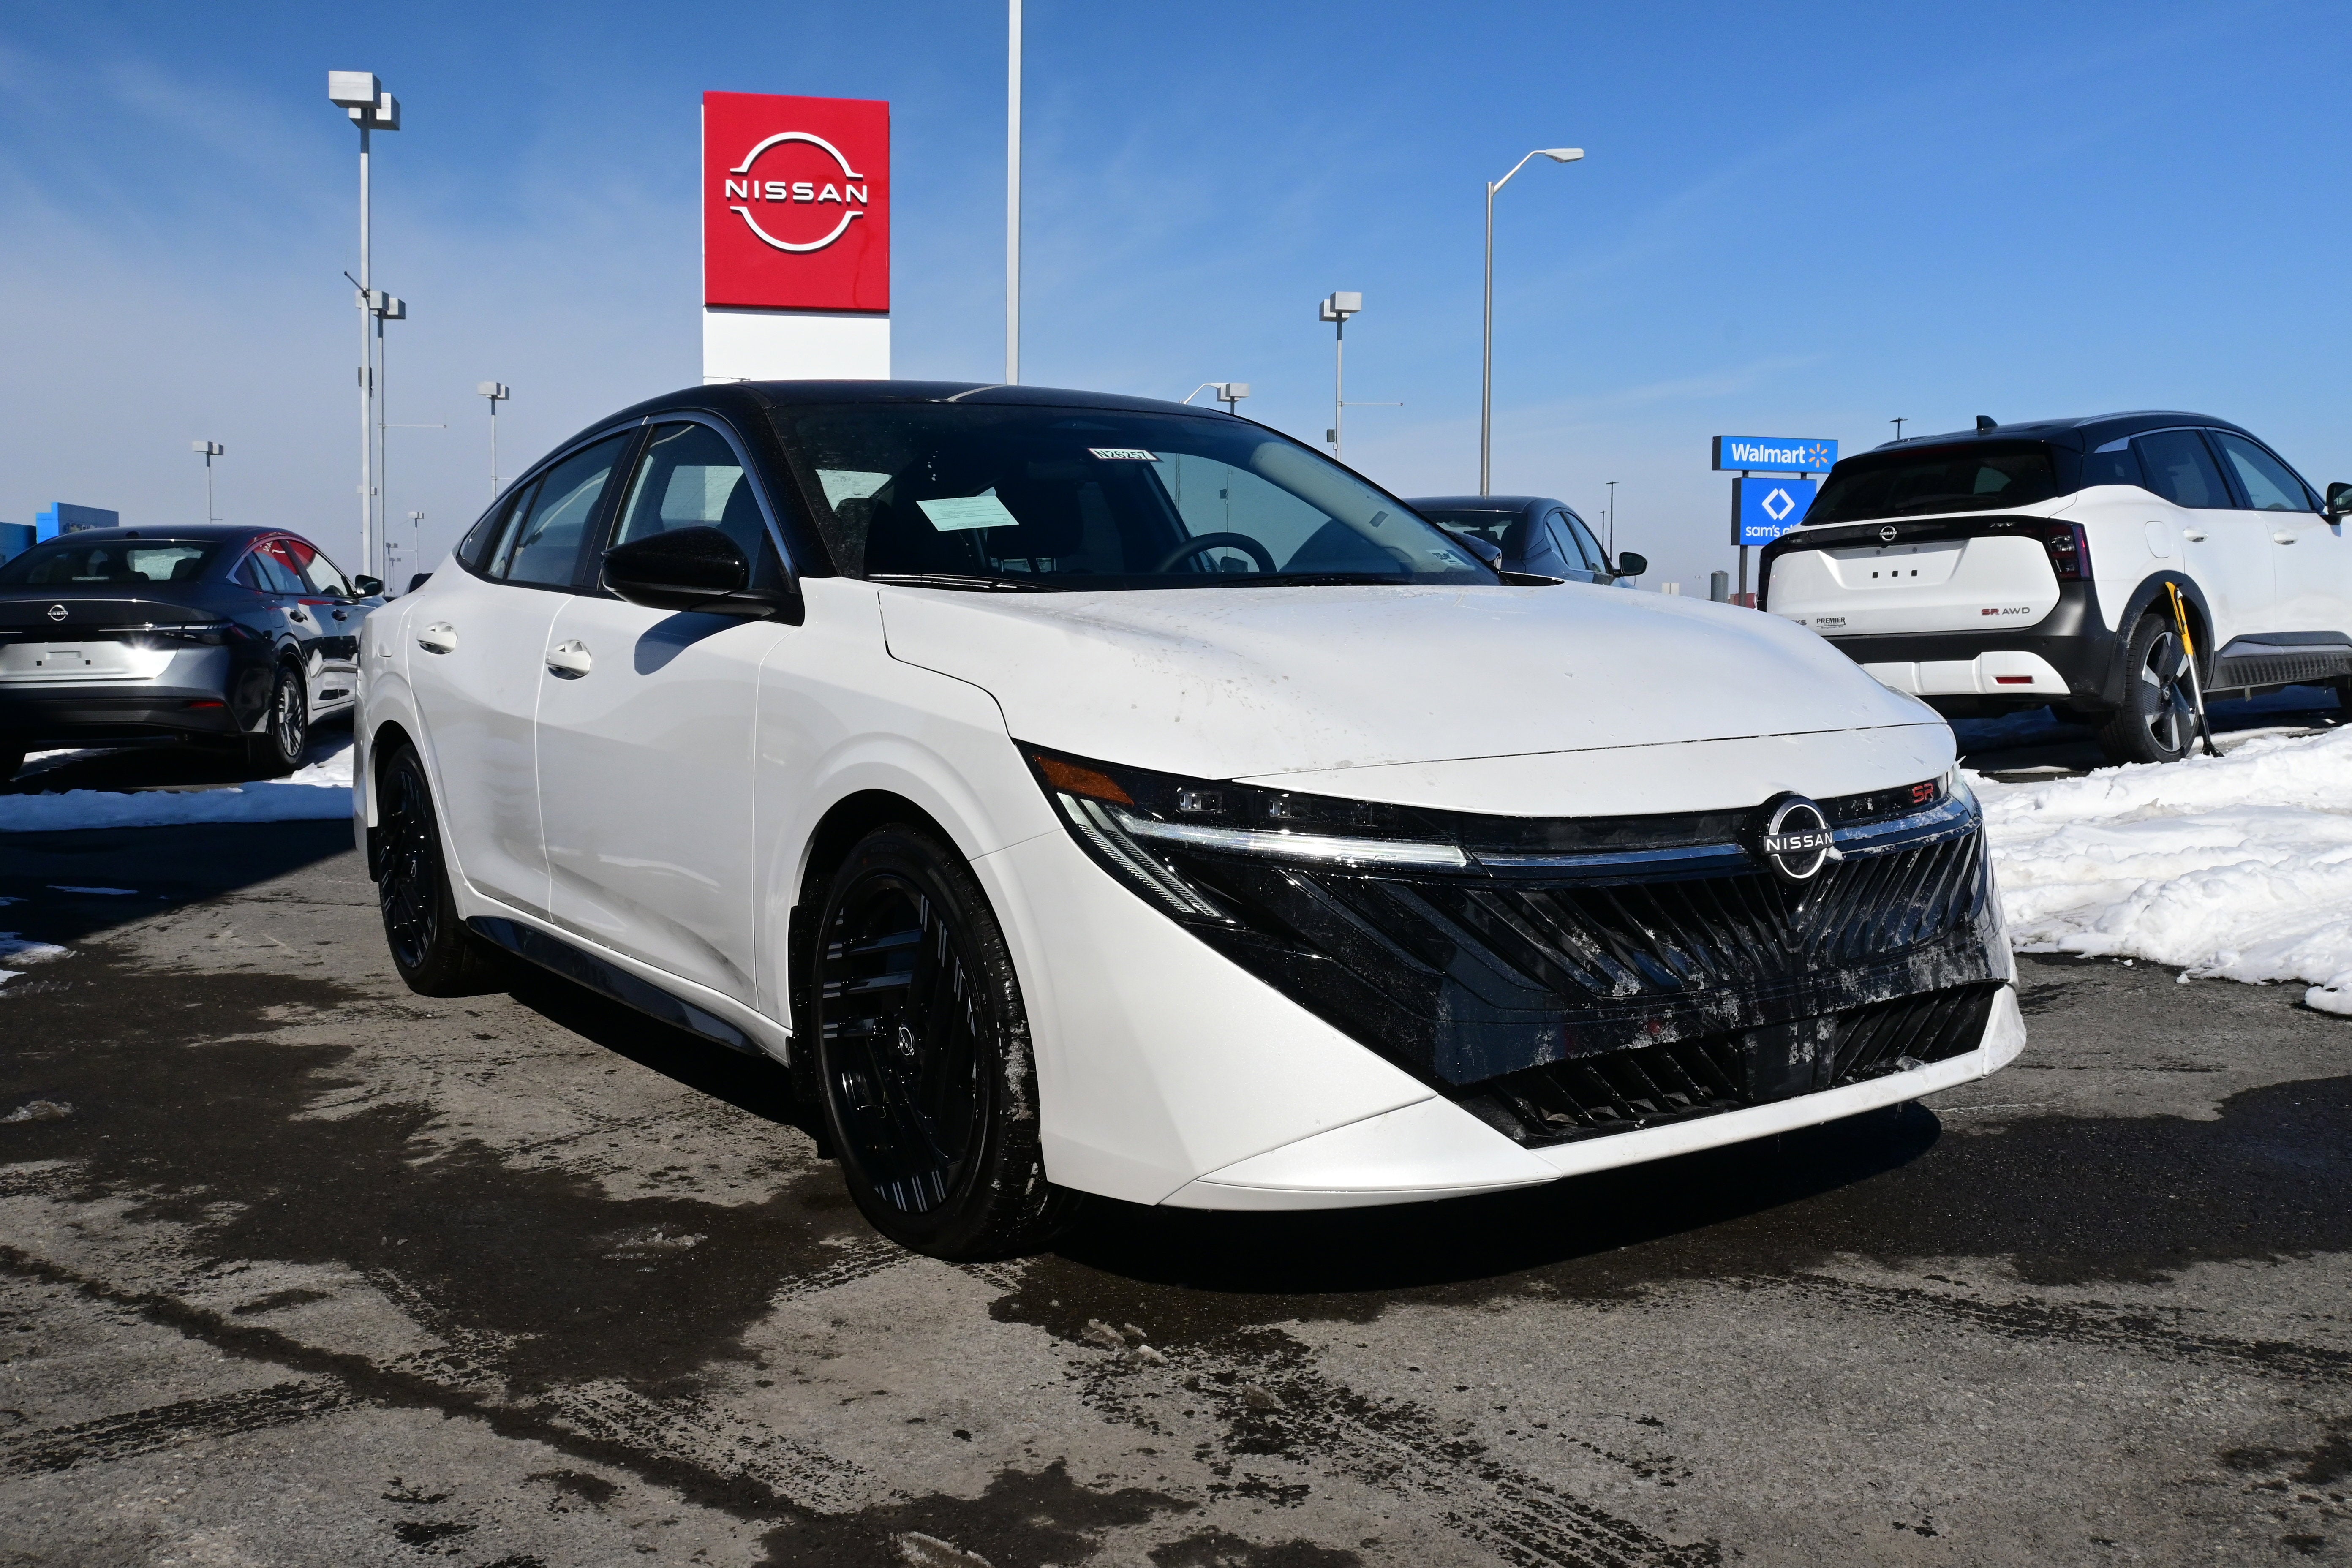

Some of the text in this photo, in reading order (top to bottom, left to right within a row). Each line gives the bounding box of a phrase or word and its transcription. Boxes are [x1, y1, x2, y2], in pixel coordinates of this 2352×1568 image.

[725, 179, 867, 203] NISSAN
[1094, 450, 1149, 460] N26257
[1732, 444, 1805, 463] Walmart
[1745, 525, 1780, 537] sam's
[1913, 783, 1934, 804] SR
[1767, 832, 1832, 851] NISSAN
